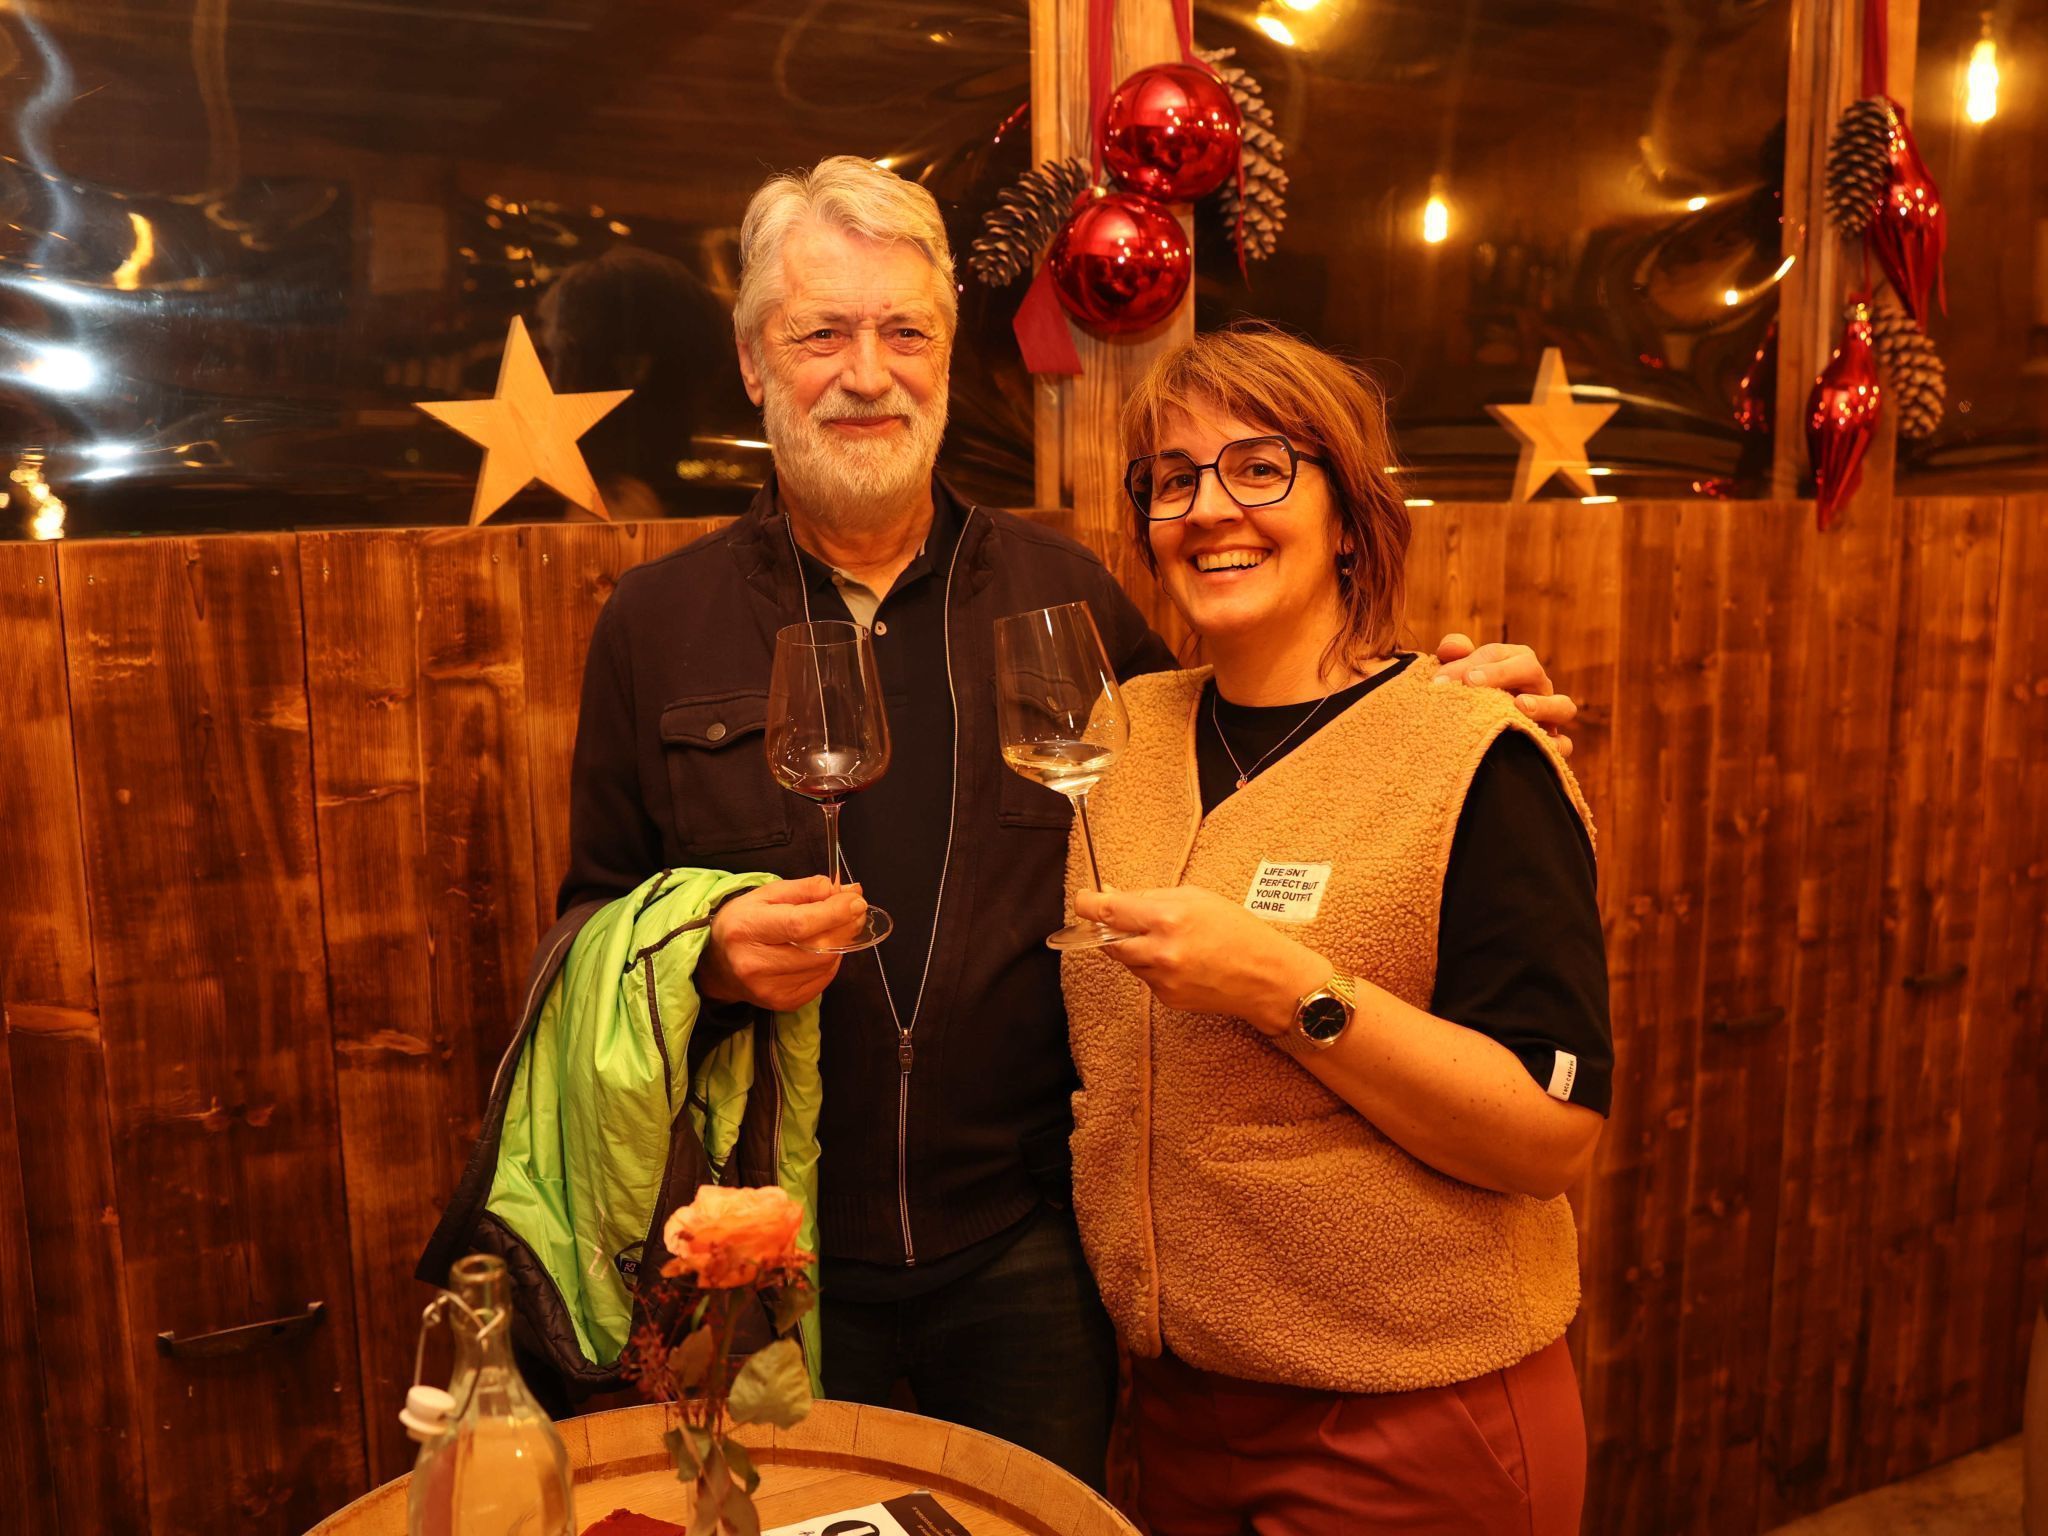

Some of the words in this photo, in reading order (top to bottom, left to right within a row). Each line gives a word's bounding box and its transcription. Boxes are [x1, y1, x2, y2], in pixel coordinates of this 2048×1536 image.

[1264, 868, 1285, 876] LIFE
[1259, 878, 1301, 889] PERFECT
[1302, 881, 1319, 890] BUT
[1256, 889, 1281, 899] YOUR
[1282, 891, 1313, 901] OUTFIT
[1251, 900, 1271, 910] CAN
